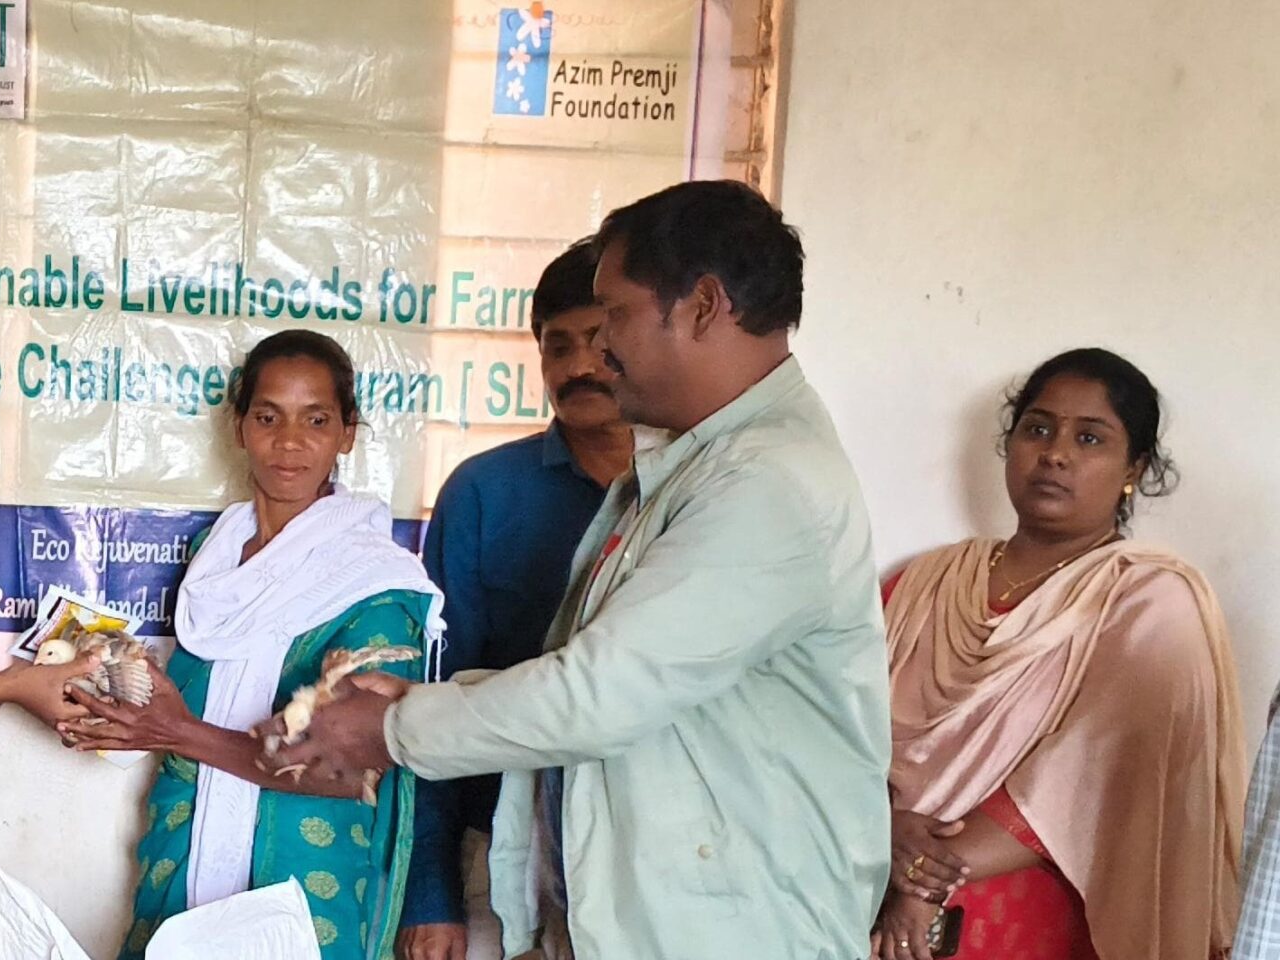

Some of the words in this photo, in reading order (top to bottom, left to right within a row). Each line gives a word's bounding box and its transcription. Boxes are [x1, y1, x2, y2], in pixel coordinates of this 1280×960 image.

[552, 59, 603, 86] Azim
[610, 60, 678, 96] Premji
[551, 91, 676, 121] Foundation
[120, 257, 363, 321] Livelihoods
[379, 266, 436, 324] for
[31, 528, 69, 562] Eco
[75, 532, 190, 574] Rejuvenati
